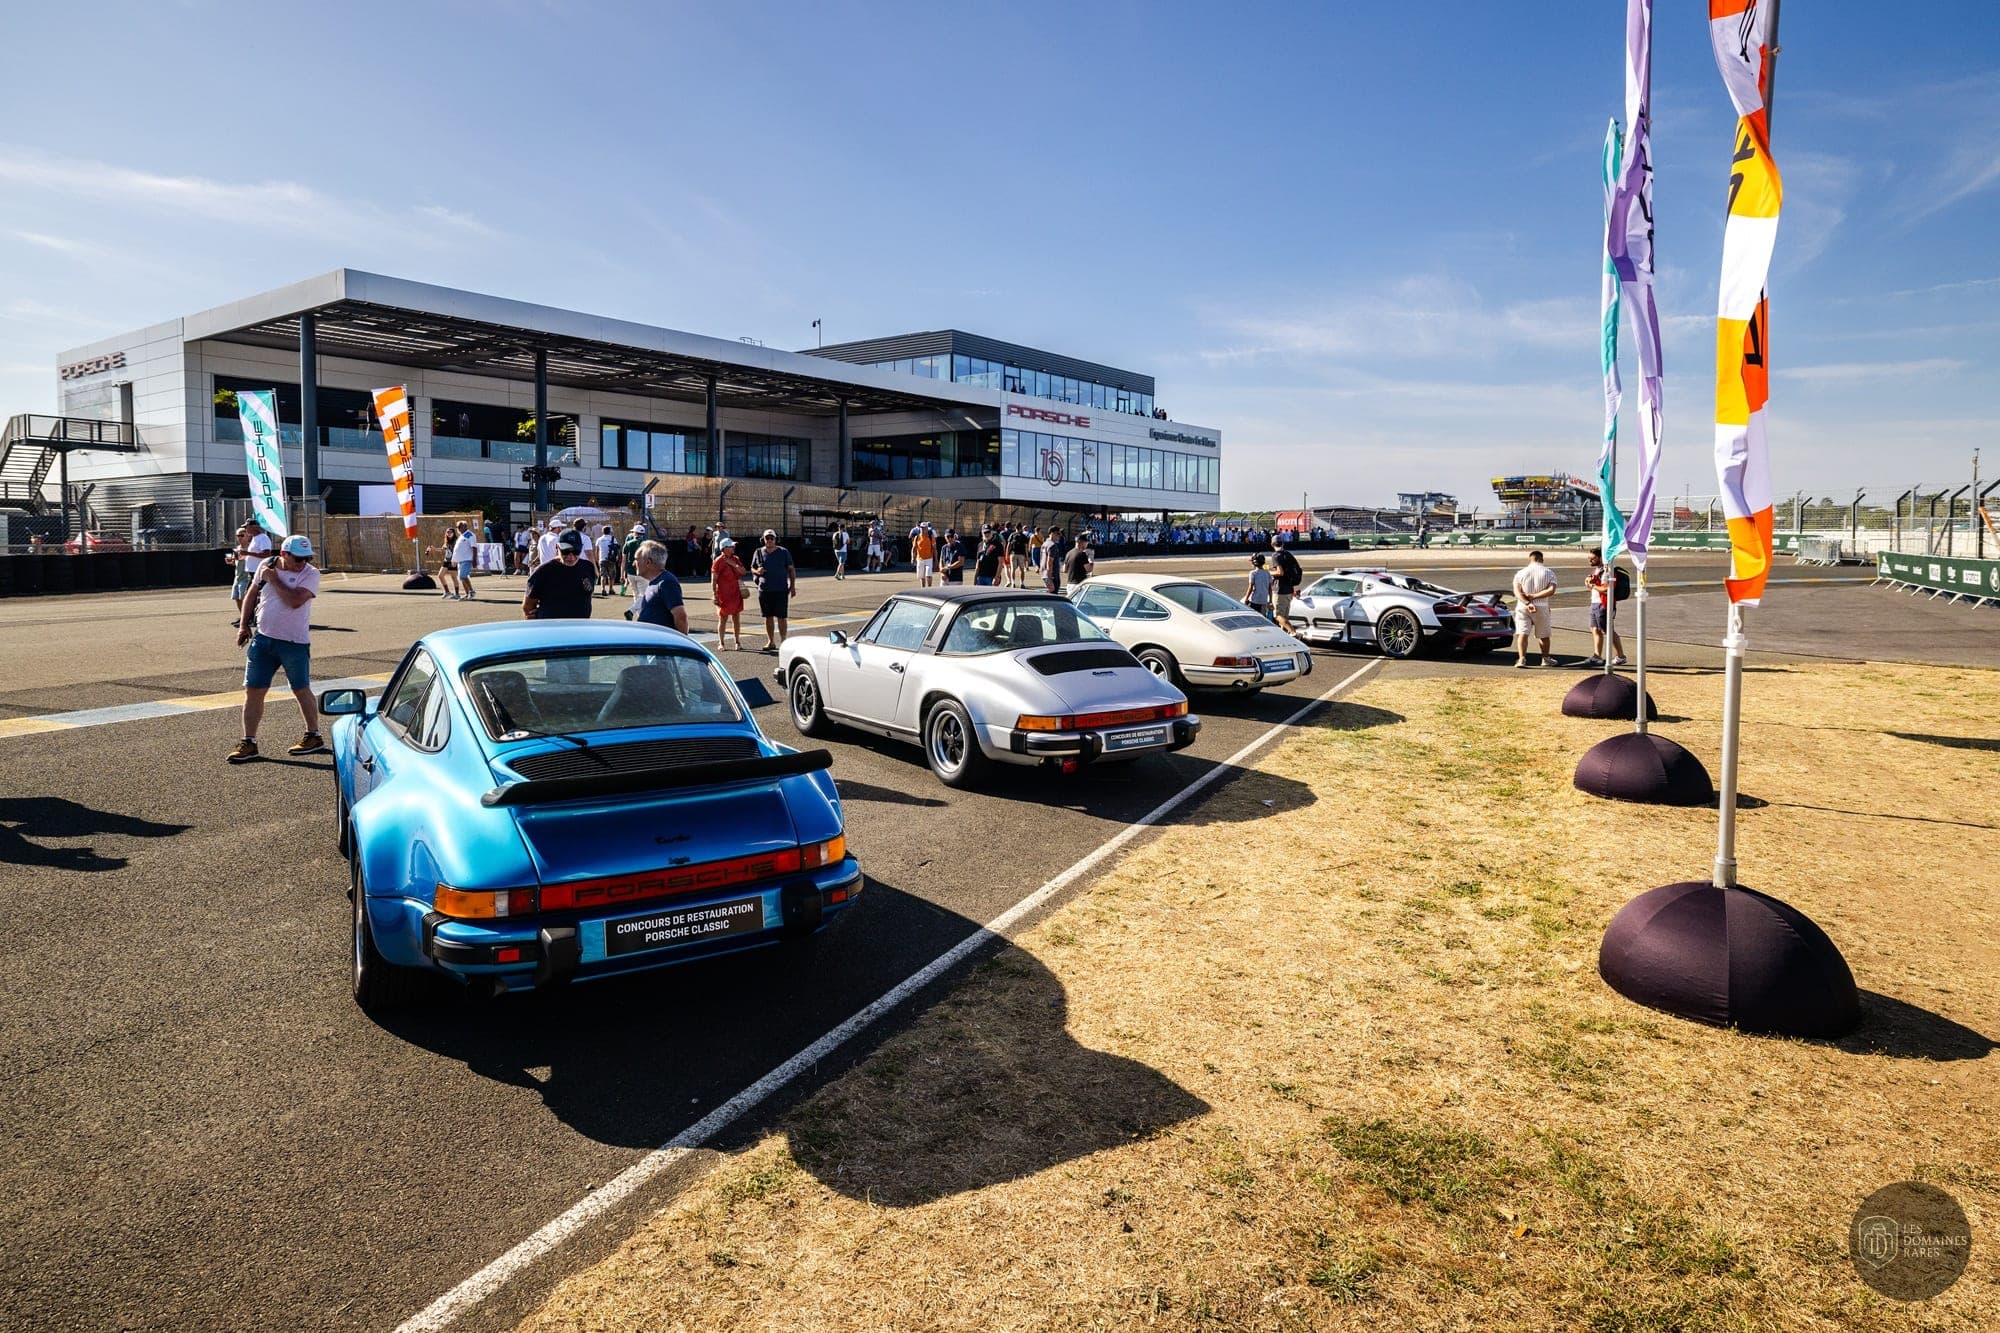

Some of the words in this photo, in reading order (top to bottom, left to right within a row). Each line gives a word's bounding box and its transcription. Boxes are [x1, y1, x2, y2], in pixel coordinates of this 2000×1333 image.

[60, 351, 126, 380] PORSCHE
[1007, 404, 1091, 429] PORSCHE
[574, 859, 777, 902] PORSCHE
[617, 916, 671, 934] CONCOURS
[672, 913, 685, 925] DE
[687, 903, 754, 923] RESTAURATION
[645, 926, 690, 943] PORSCHE
[691, 919, 730, 935] CLASSIC
